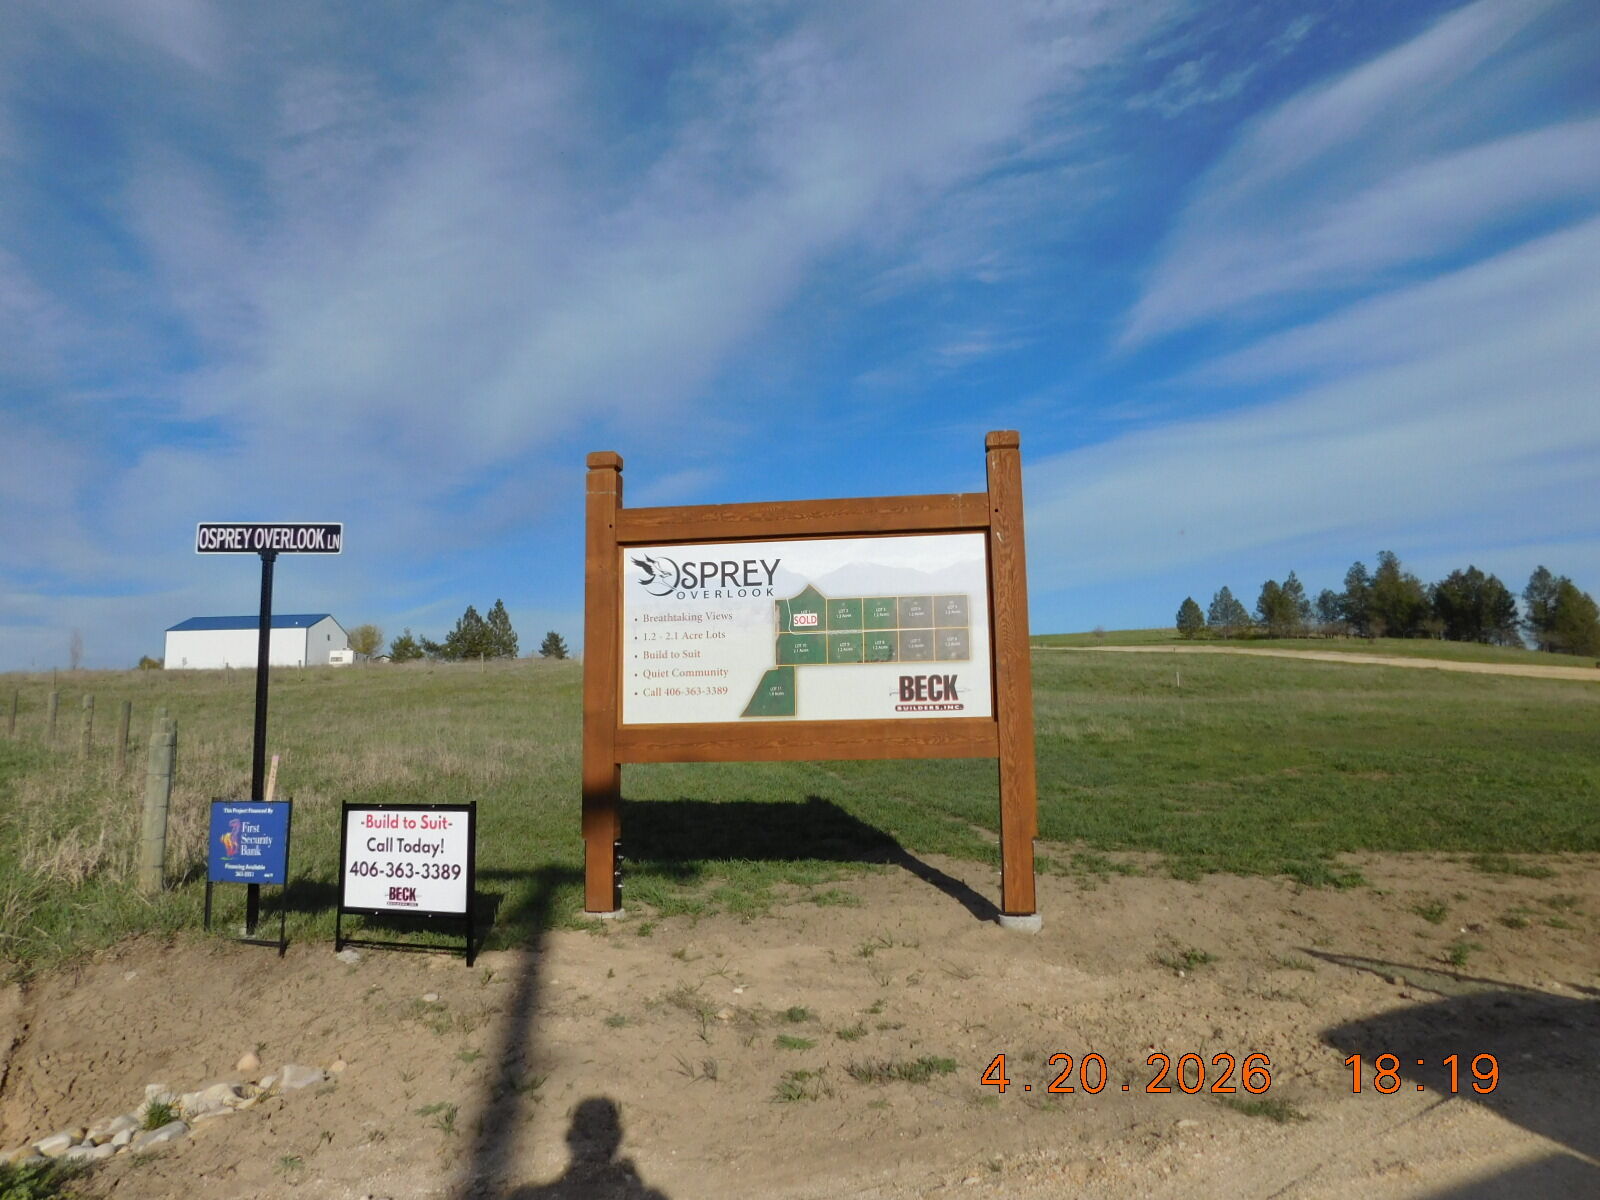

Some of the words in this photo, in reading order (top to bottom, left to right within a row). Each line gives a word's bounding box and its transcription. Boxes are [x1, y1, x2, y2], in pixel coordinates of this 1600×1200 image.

[199, 527, 253, 549] OSPREY
[254, 527, 326, 549] OVERLOOK
[327, 534, 340, 549] LN
[676, 588, 775, 600] OVERLOOK
[643, 612, 703, 624] Breathtaking
[705, 611, 733, 621] Views
[794, 615, 817, 625] SOLD
[643, 632, 656, 641] 1.2
[665, 631, 678, 641] 2.1
[681, 631, 703, 640] Acre
[705, 630, 726, 640] Lots
[643, 650, 668, 660] Build
[670, 650, 680, 659] to
[682, 649, 701, 659] Suit
[642, 669, 669, 679] Quiet
[671, 667, 729, 679] Community
[642, 687, 662, 697] Call
[664, 686, 728, 696] 406-363-3389
[898, 674, 959, 702] BECK
[241, 821, 260, 833] First
[403, 816, 417, 829] to
[241, 833, 272, 848] Security
[240, 845, 262, 856] Bank
[366, 837, 393, 852] Call
[396, 837, 445, 858] Today!
[349, 861, 462, 880] 406-363-3389
[388, 886, 417, 902] BECK
